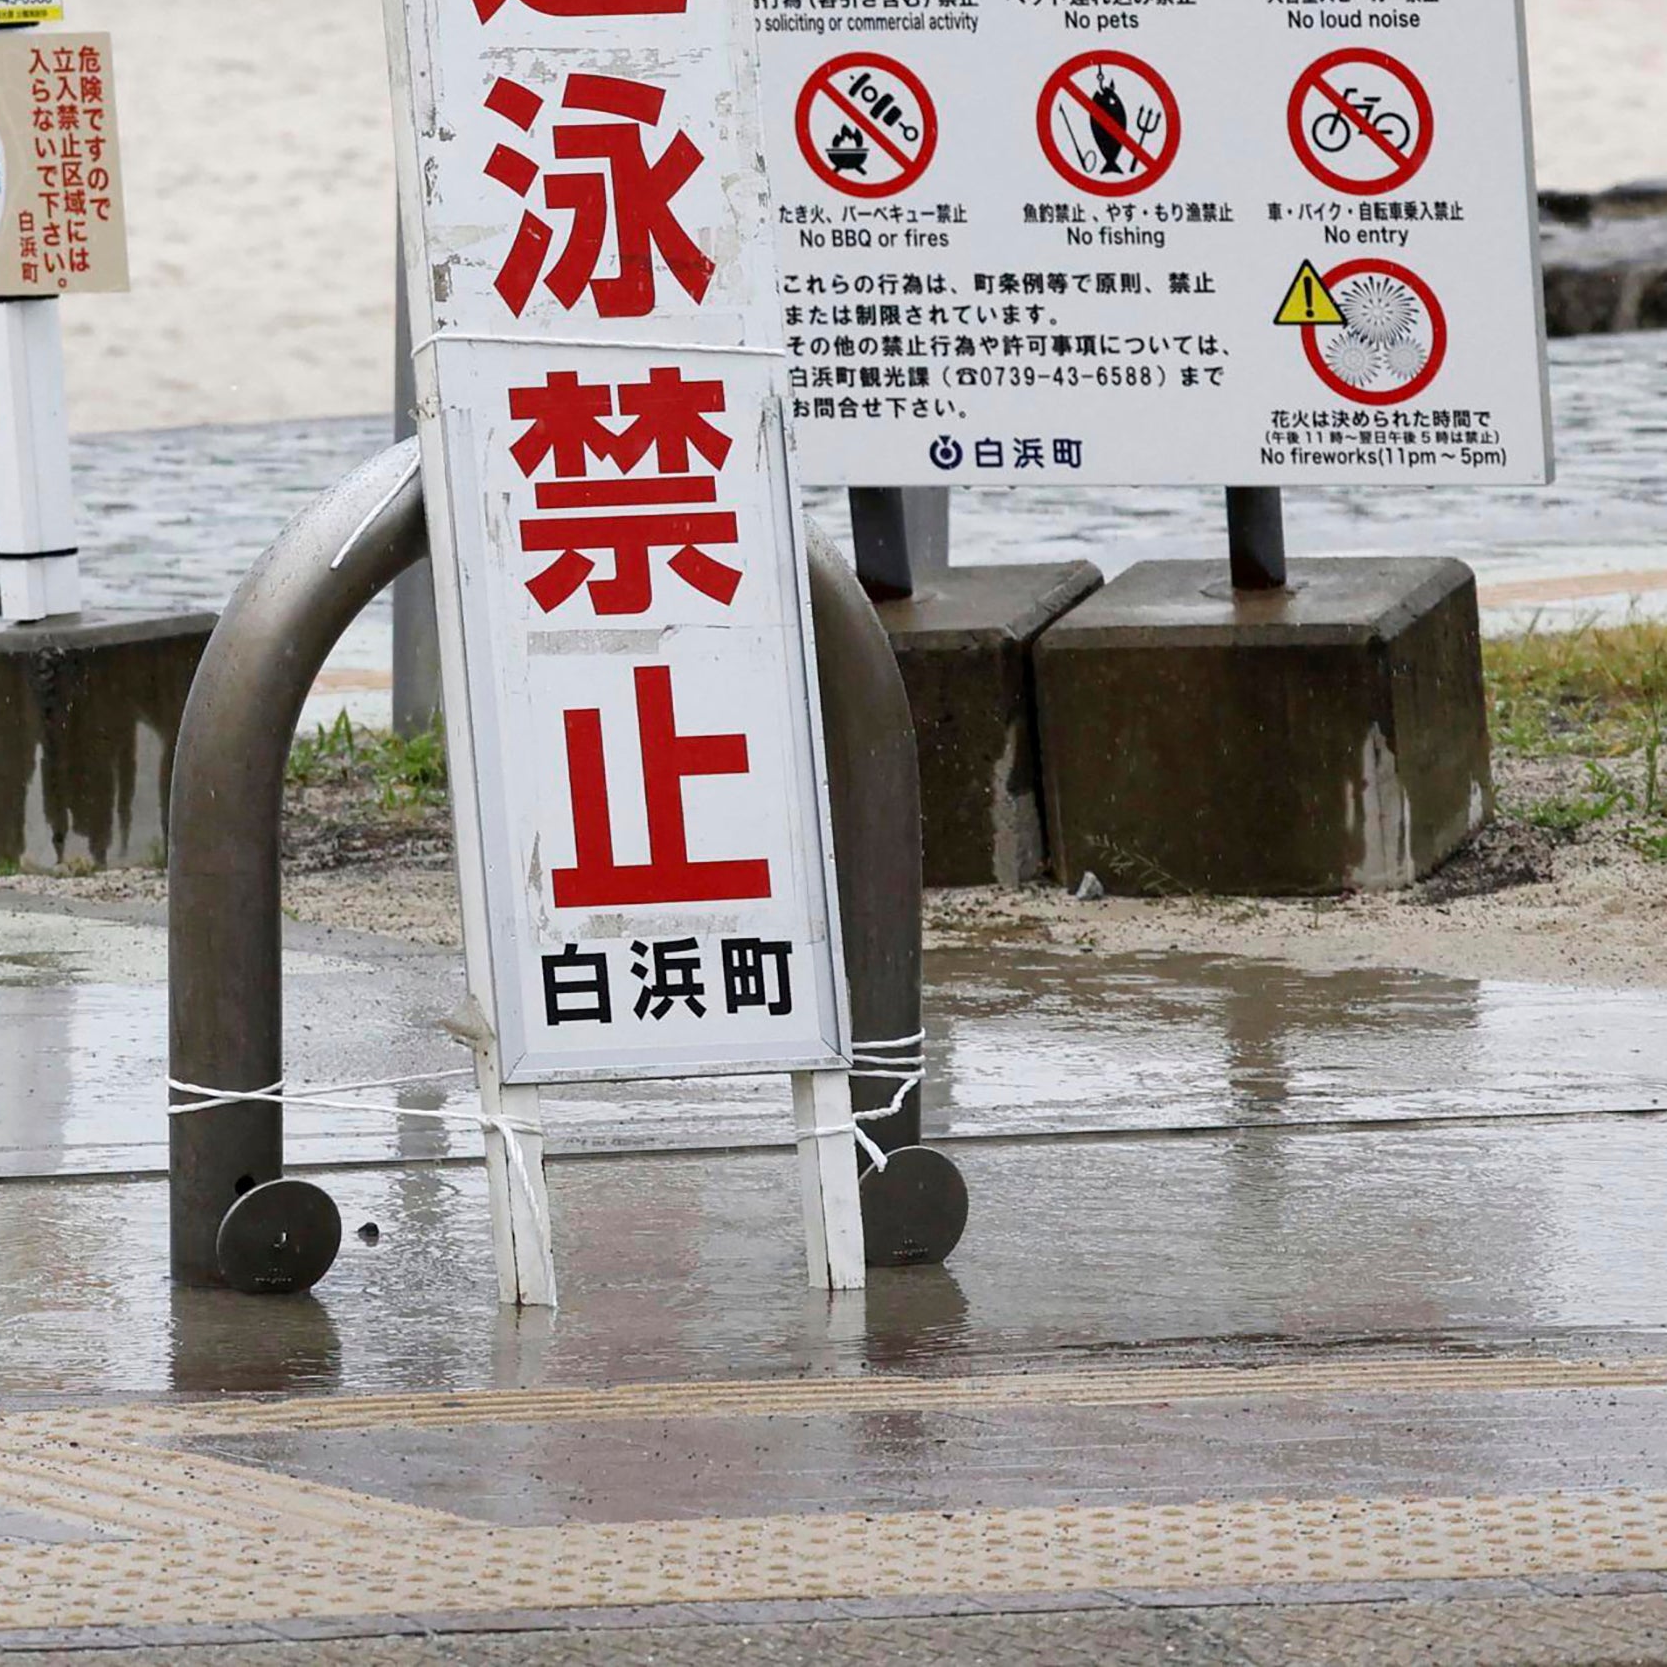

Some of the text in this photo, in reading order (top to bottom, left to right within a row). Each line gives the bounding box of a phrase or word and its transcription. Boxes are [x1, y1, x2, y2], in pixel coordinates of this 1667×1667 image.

[765, 12, 825, 35] soliciting
[829, 16, 843, 31] or
[847, 12, 926, 32] commercial
[929, 10, 979, 34] activity
[1065, 10, 1140, 33] No pets
[1288, 8, 1421, 29] No loud noise
[78, 45, 110, 222] 危険ですので
[28, 48, 68, 289] 入らないで下さい。
[53, 47, 91, 274] 立入禁止区域には
[779, 203, 969, 224] たき火、バーベキュー禁止
[1023, 201, 1235, 224] 魚釣禁止、やす・もり漁禁止
[1267, 200, 1465, 223] 車・バイク・自転車乗入禁止
[18, 210, 39, 284] 白浜町
[800, 227, 950, 248] No BBQ or fires
[1067, 225, 1166, 249] No fishing
[1324, 225, 1410, 248] No entry
[783, 270, 1217, 297] これらの行為は、町条例等で原則、禁止
[785, 303, 1058, 326] または制限されています。
[786, 334, 1230, 357] その他の禁止行為や許可事項については、
[792, 395, 967, 419] お問合せ下さい。
[1271, 409, 1492, 429] 花火は決められた時間で
[975, 436, 1084, 470] 白浜町
[1261, 447, 1285, 465] No
[539, 936, 794, 1027] 白浜町
